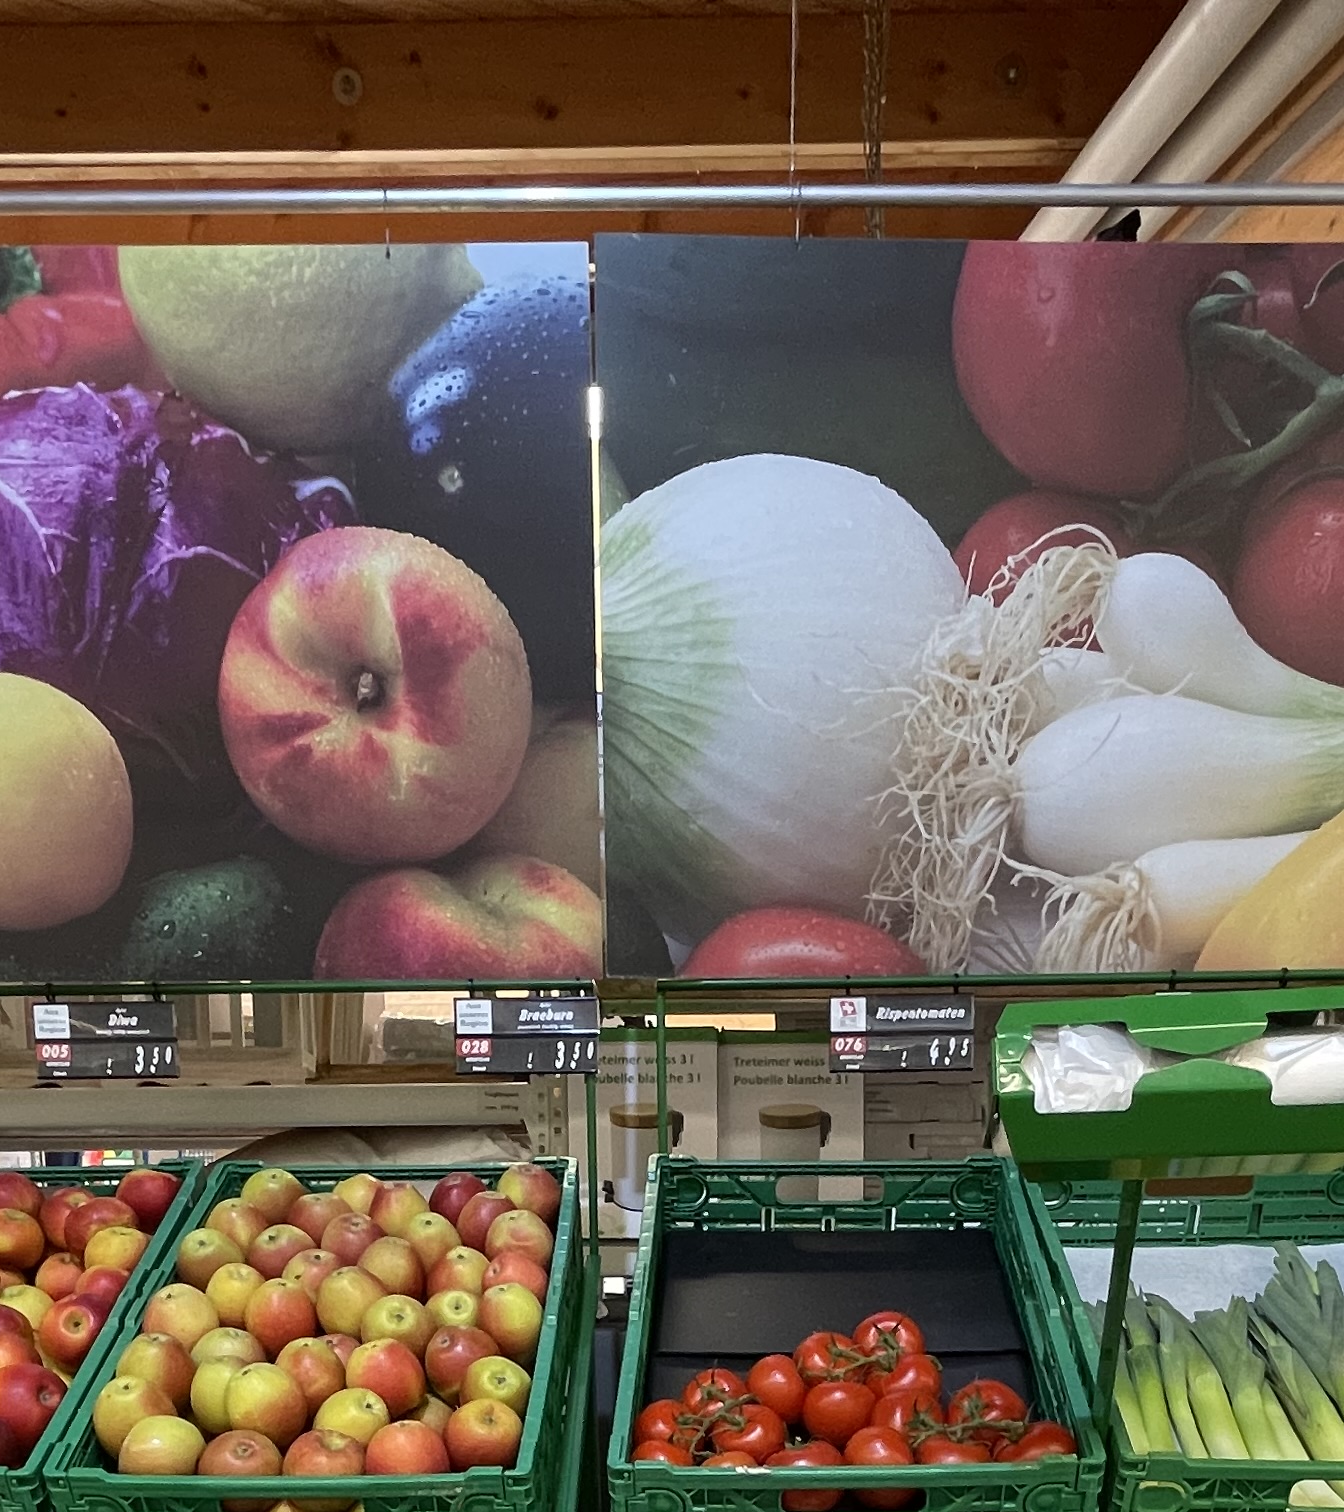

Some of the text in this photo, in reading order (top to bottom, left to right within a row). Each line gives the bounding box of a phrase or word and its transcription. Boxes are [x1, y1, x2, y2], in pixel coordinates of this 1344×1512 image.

[518, 1008, 575, 1022] Braeburn
[875, 1006, 966, 1022] Rispentomaten
[41, 1044, 70, 1059] 005
[461, 1040, 489, 1055] 028
[834, 1038, 863, 1052] 076
[680, 1055, 687, 1065] 3
[733, 1055, 825, 1067] Treteimer weiss
[687, 1074, 695, 1083] 3
[733, 1075, 784, 1086] Poubelle
[786, 1073, 832, 1085] blanche
